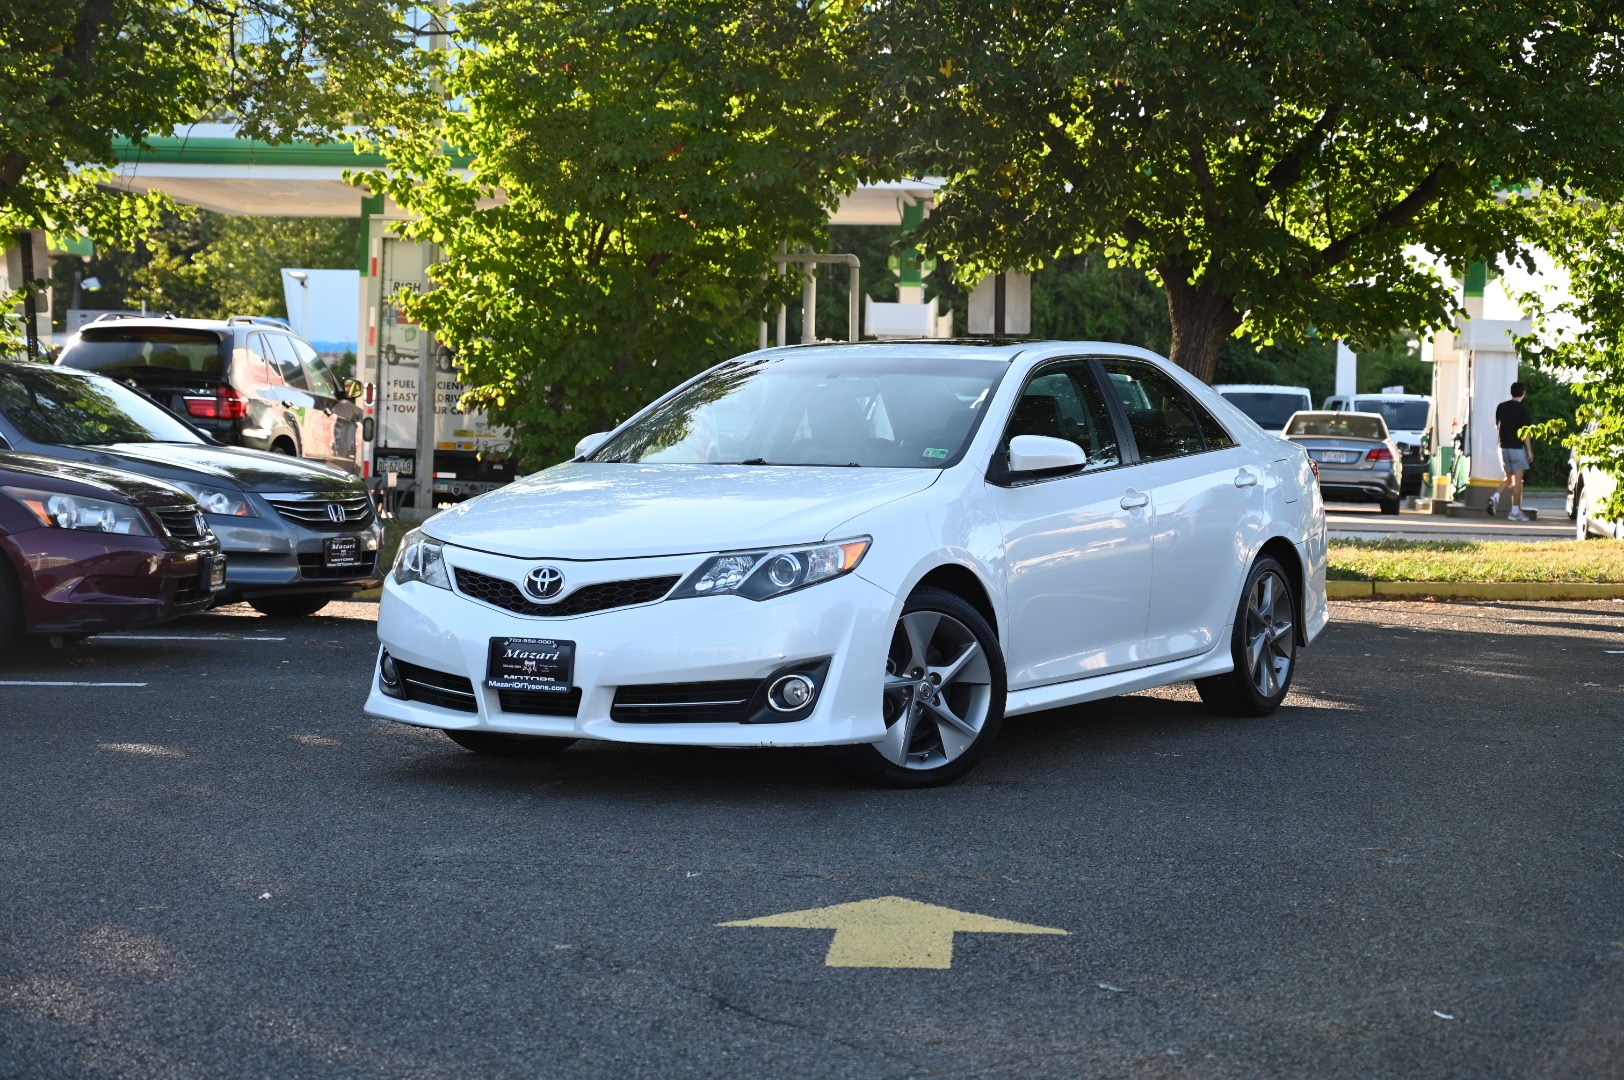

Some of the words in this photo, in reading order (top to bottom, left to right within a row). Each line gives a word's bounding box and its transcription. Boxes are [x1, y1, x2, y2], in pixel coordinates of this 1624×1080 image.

[393, 281, 421, 292] RIGH
[393, 380, 416, 389] FUEL
[393, 392, 418, 401] EASY
[437, 394, 463, 402] DRIV
[393, 404, 417, 413] TOW
[434, 406, 448, 414] UR
[502, 649, 560, 661] Mazari
[488, 680, 567, 692] MazariOfTysons.com
